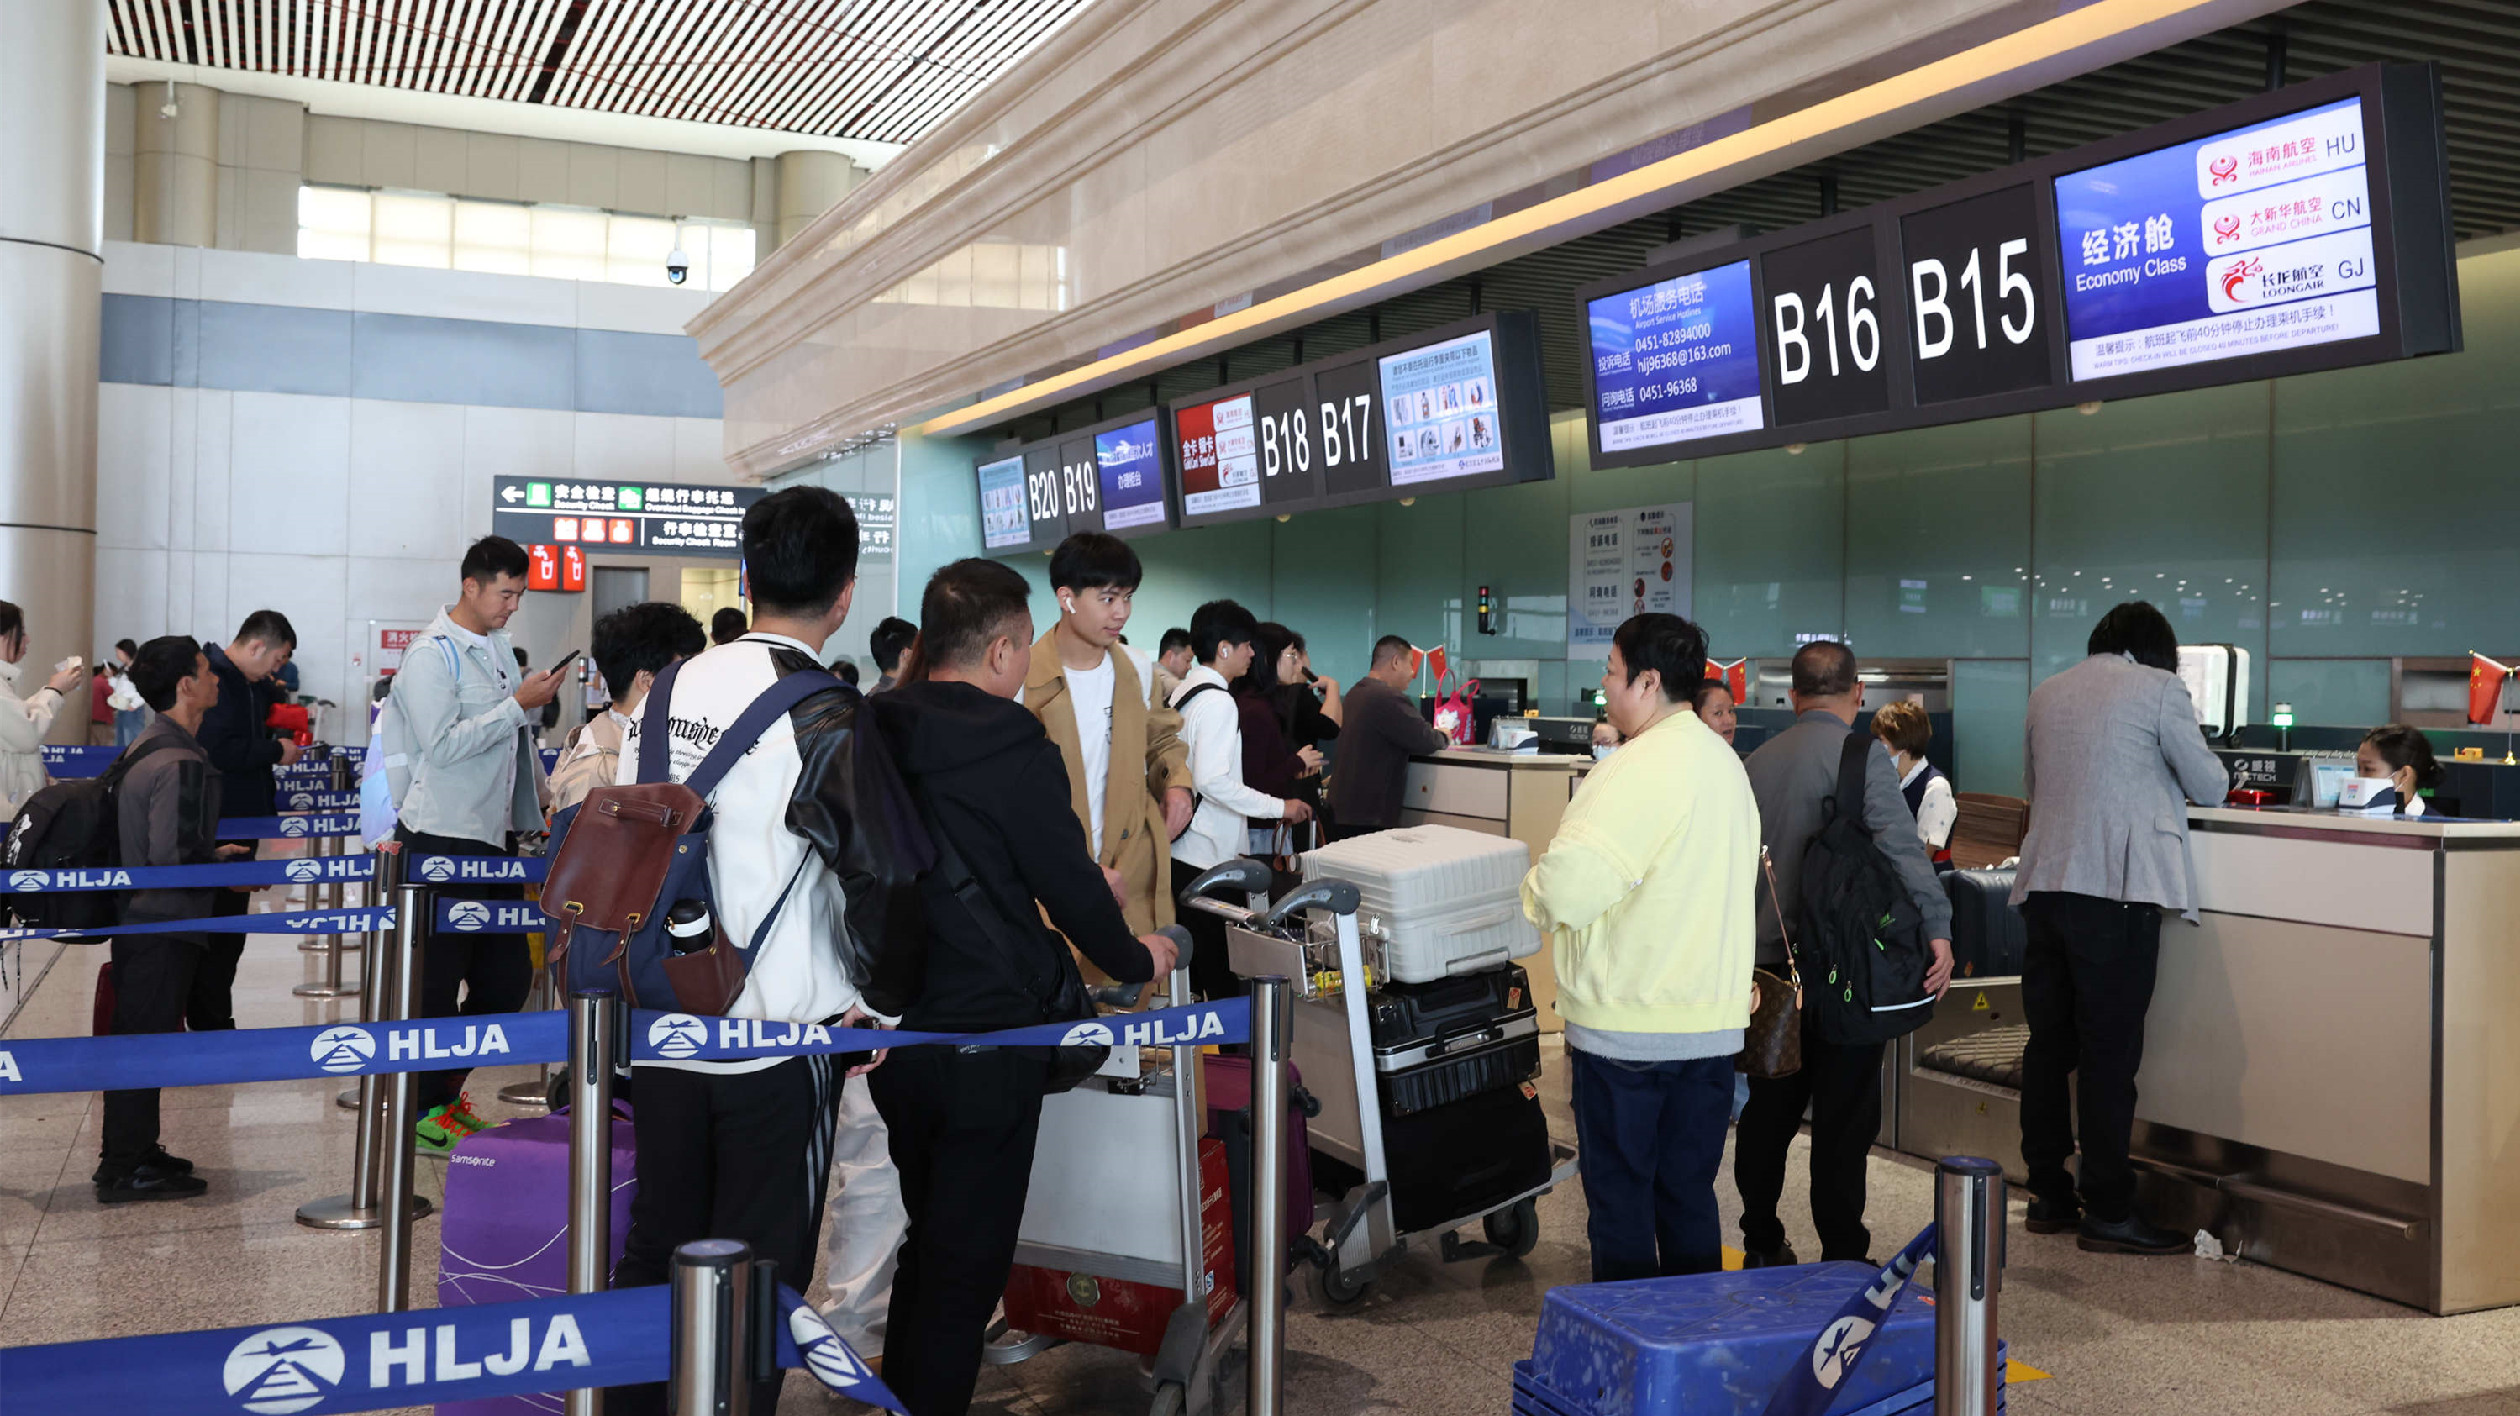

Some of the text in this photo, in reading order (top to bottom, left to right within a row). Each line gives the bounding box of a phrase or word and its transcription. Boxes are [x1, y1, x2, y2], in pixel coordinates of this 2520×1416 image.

[2248, 137, 2316, 167] 海南航空
[2326, 133, 2355, 157] HU
[2250, 197, 2321, 224] 大新华航空
[2331, 197, 2361, 220] CN
[2081, 213, 2175, 266] 经济舱
[2251, 214, 2323, 237] GRAND CHINA
[2076, 256, 2187, 293] Economy Class
[2338, 258, 2364, 280] GJ
[1913, 238, 2034, 359] B15
[2263, 280, 2324, 299] LOONGAIR
[1635, 323, 1711, 352] 0451-82894000
[1775, 276, 1879, 384] B16
[1637, 343, 1731, 377] hlj96368@163.com
[1639, 376, 1698, 403] 0451-96368
[1262, 409, 1309, 476] B18
[1321, 394, 1370, 466] B17
[1029, 470, 1058, 520] B20
[1064, 461, 1095, 514] B19
[292, 763, 329, 773] HLJA
[284, 781, 326, 792] HLJA
[318, 794, 361, 807] HLJA
[58, 871, 130, 887] HLJA
[328, 859, 375, 877] HLJ
[461, 860, 526, 878] HLJA
[389, 1024, 509, 1060] HLJA
[719, 1018, 832, 1049] HLJA
[369, 1313, 592, 1389] HLJA
